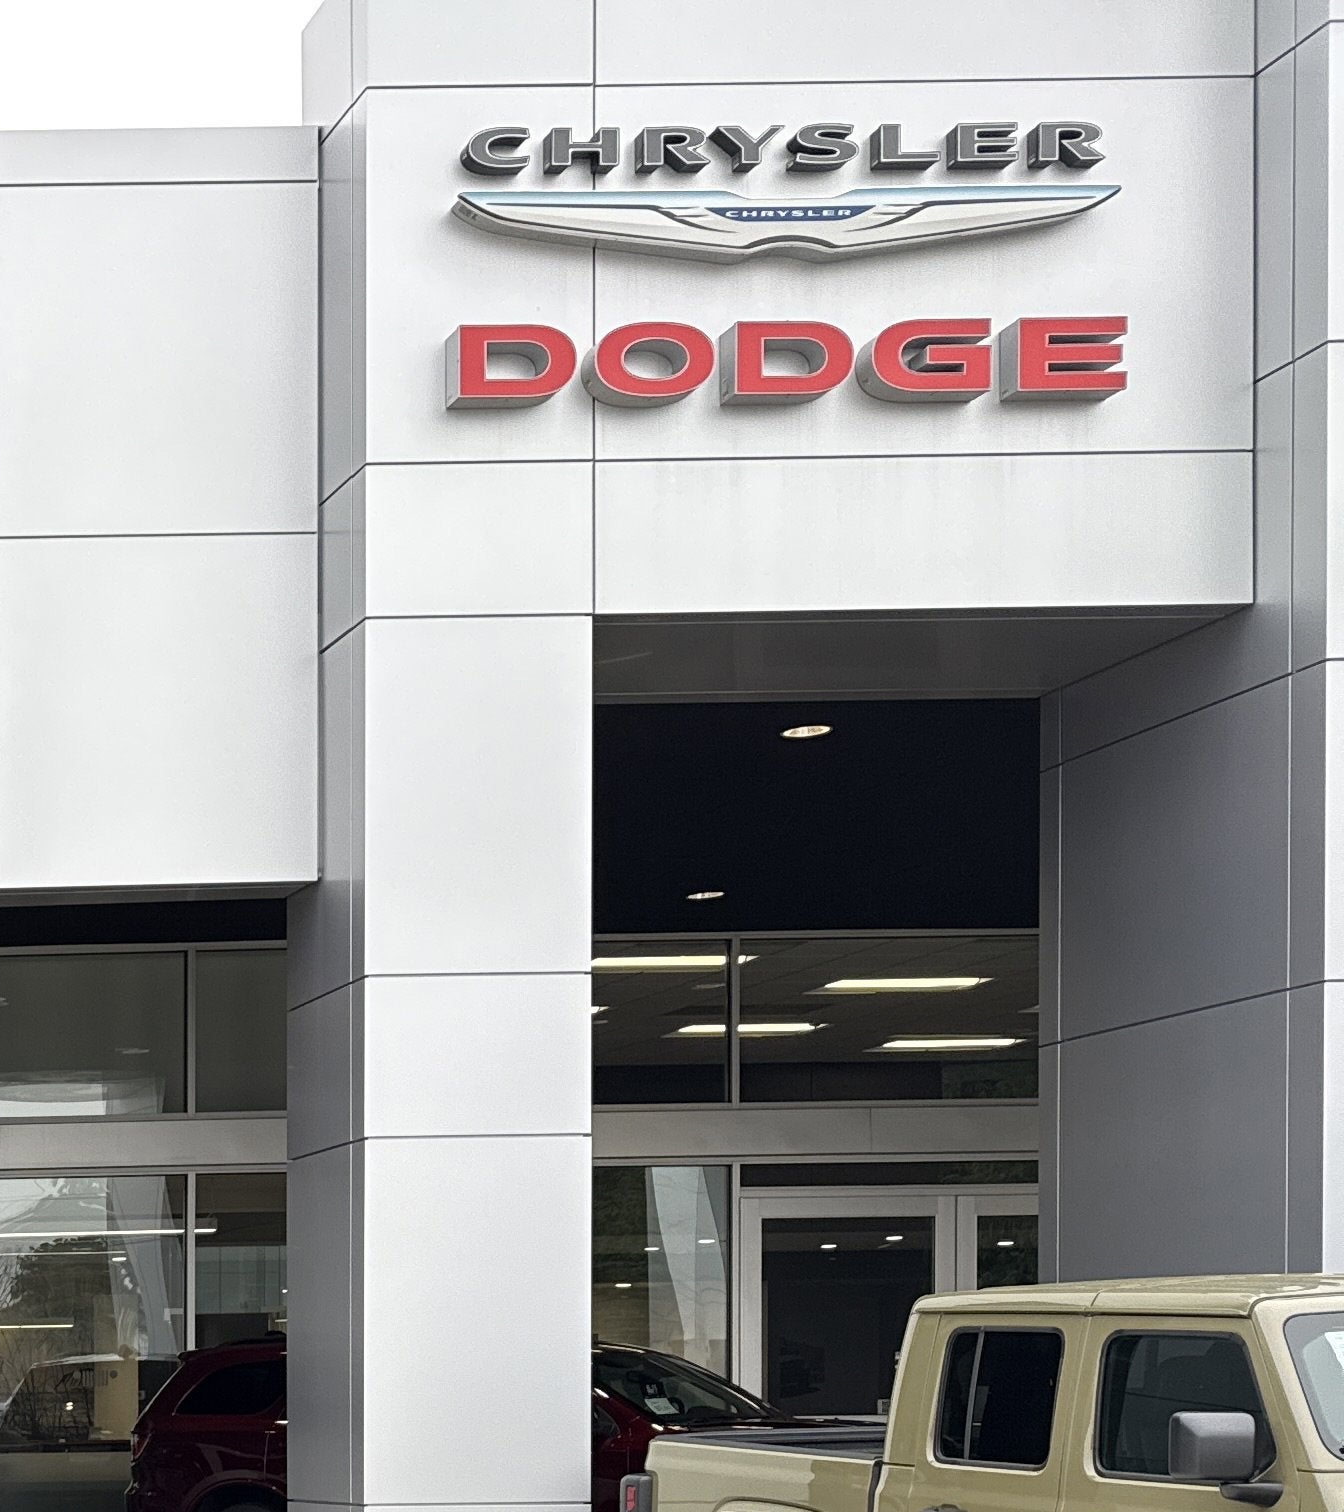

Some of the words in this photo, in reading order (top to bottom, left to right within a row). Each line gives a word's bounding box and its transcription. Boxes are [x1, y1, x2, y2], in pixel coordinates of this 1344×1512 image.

[460, 122, 1107, 174] CHRYSLER
[724, 207, 853, 219] CHRYSLER
[446, 316, 1129, 410] DODGE
